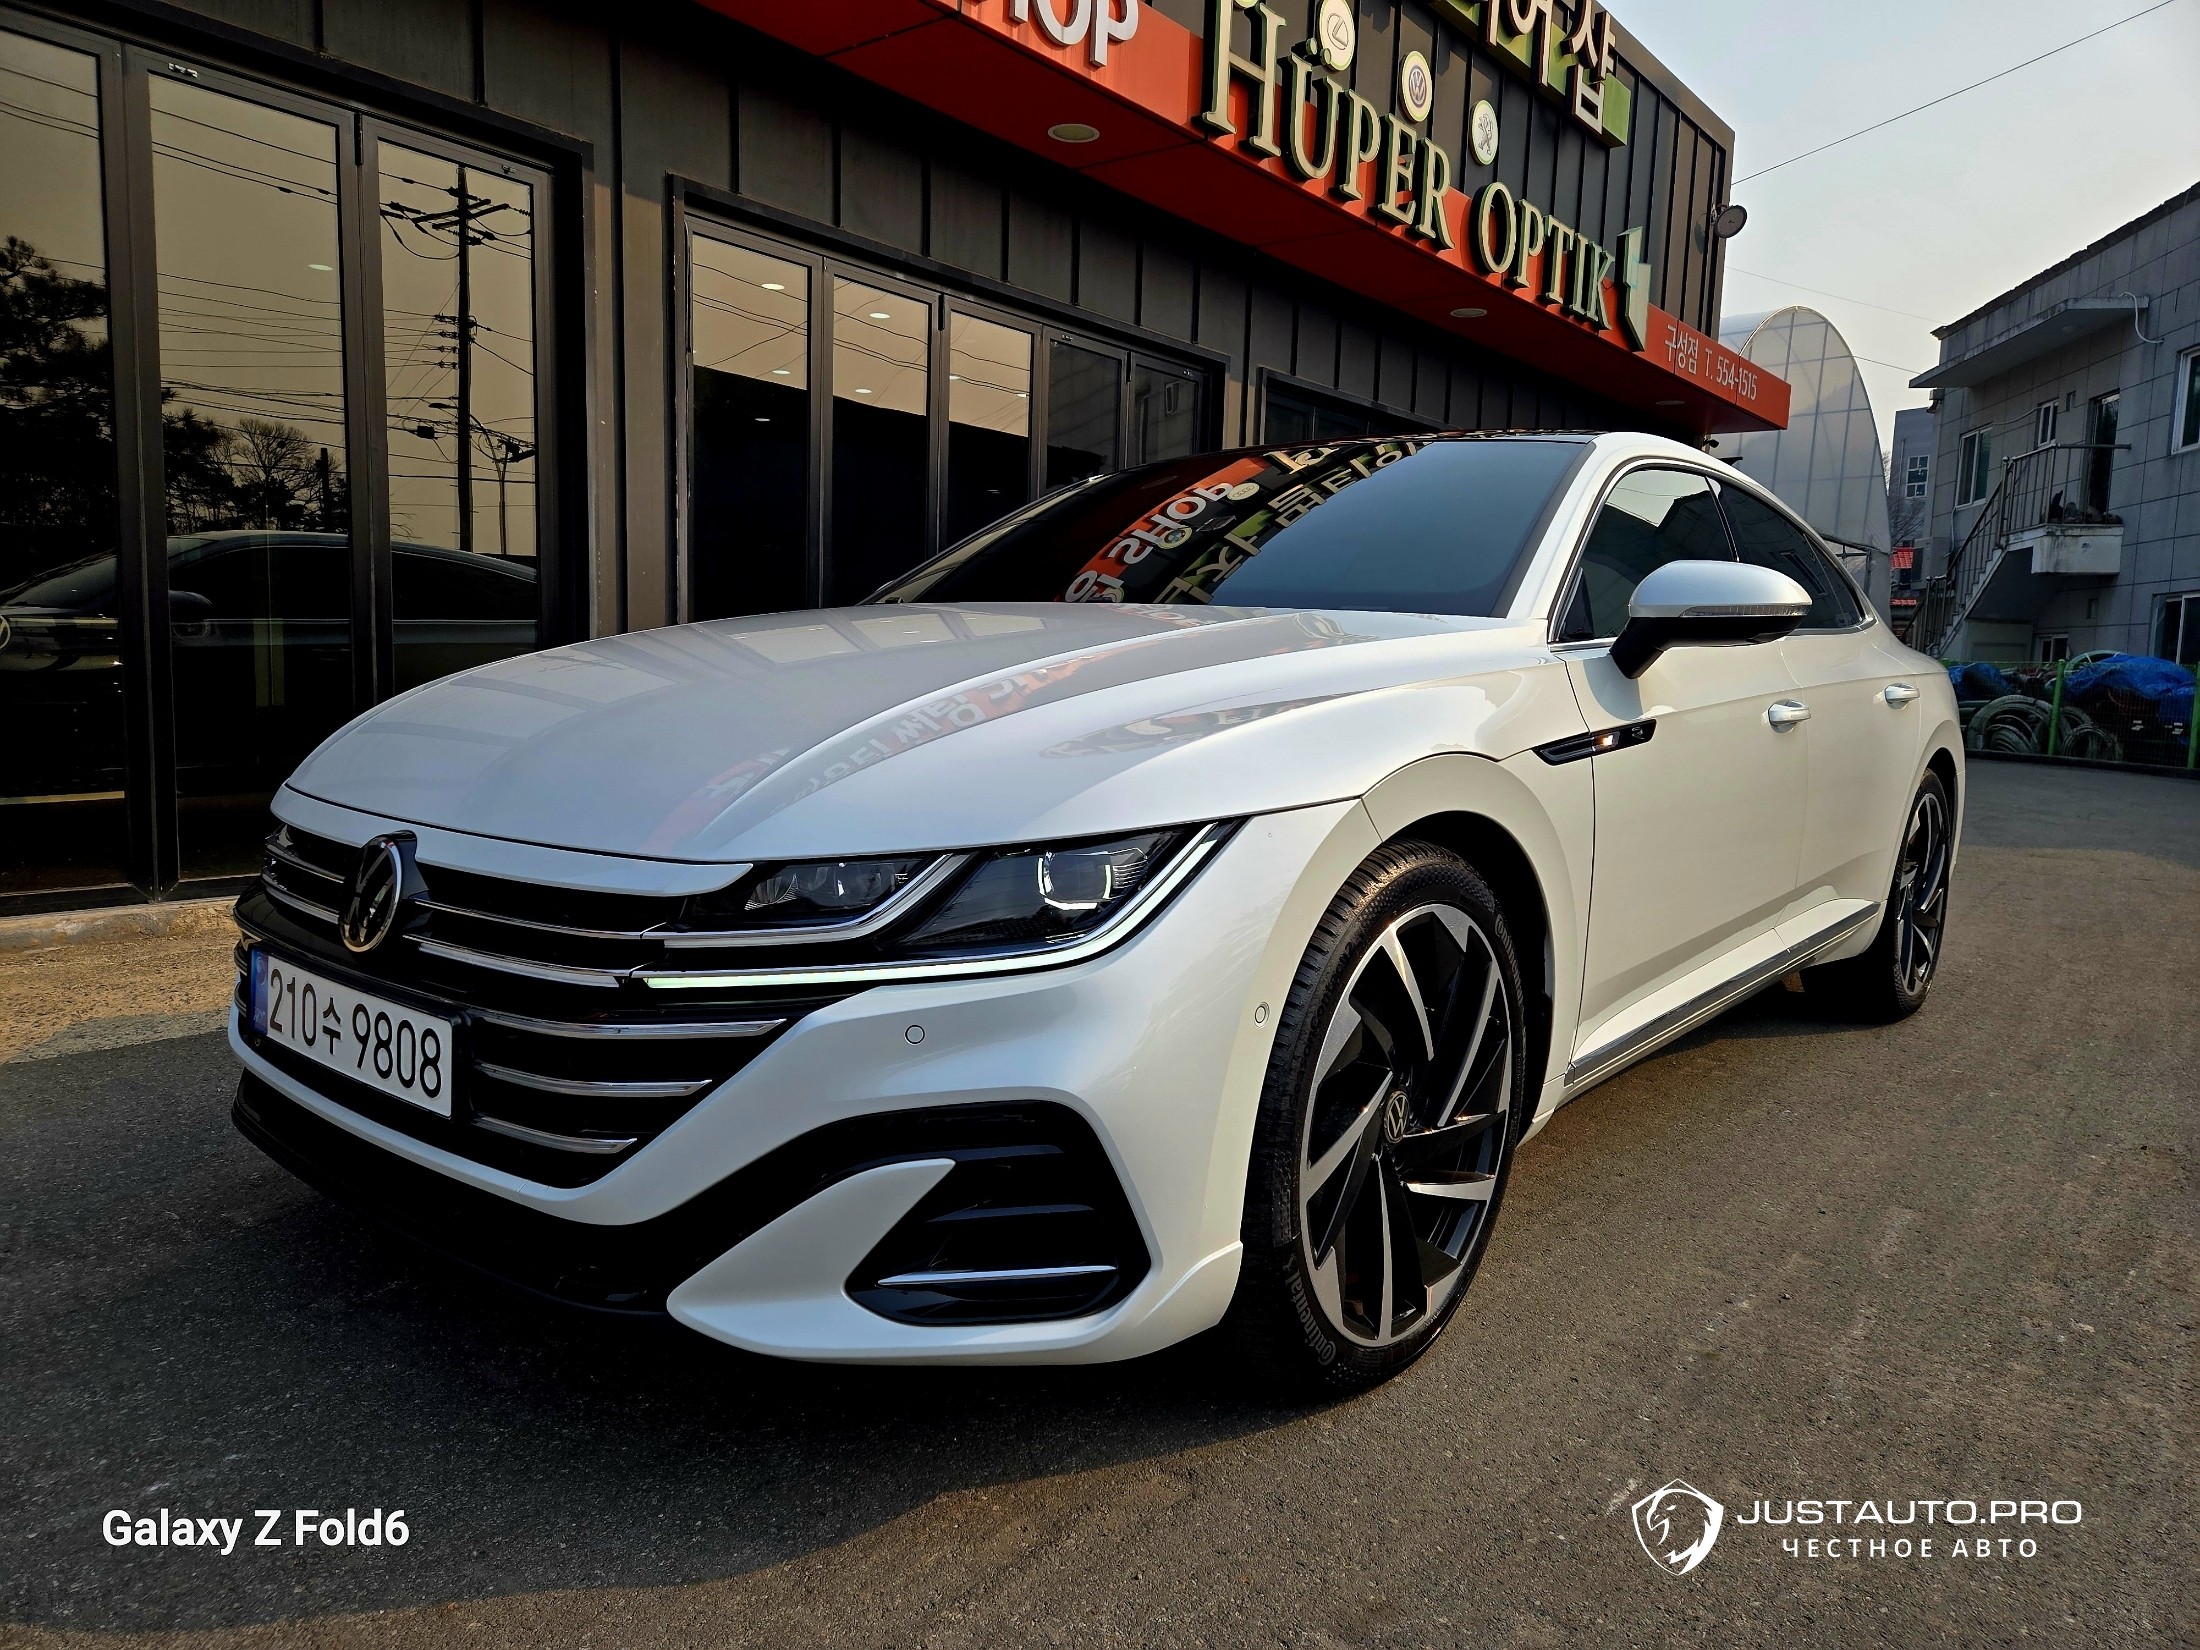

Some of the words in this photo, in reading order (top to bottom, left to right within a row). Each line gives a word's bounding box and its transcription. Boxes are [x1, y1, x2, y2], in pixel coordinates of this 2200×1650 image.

[1476, 181, 1615, 331] OPTIK
[1664, 324, 1699, 375] 구성점
[1716, 355, 1758, 401] 554-1515
[269, 968, 341, 1056] 210수
[352, 1003, 442, 1099] 9808
